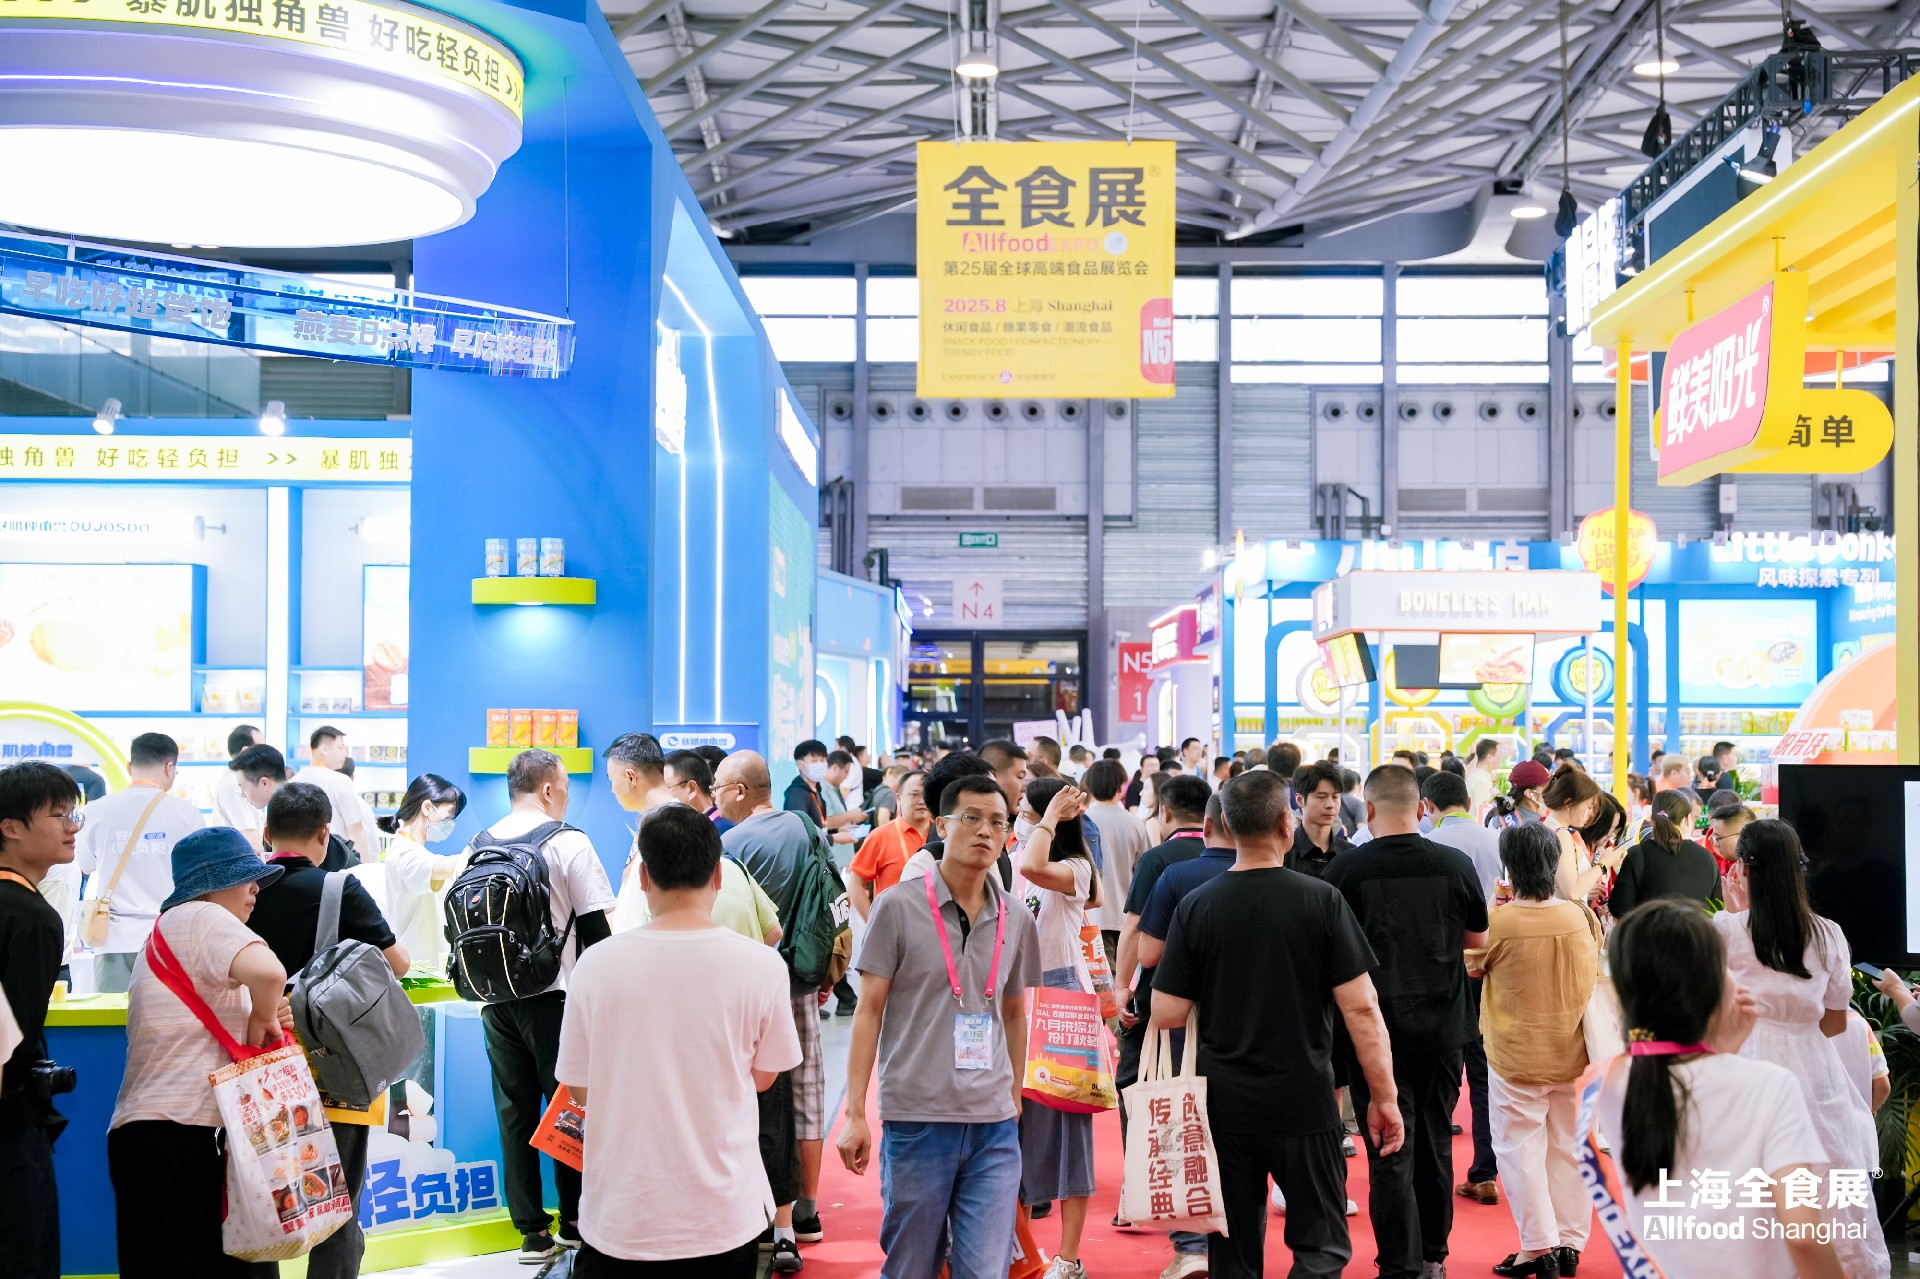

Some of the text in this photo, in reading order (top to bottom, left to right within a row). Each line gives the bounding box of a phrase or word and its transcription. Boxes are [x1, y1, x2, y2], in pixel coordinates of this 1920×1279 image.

[368, 13, 501, 94] 好吃轻负担
[943, 165, 1146, 228] 全食展
[943, 260, 1149, 276] 第25届全球高端食品展览会
[23, 270, 232, 330] 早吃好超管饱
[944, 298, 1113, 314] 2025.8 上海 Shanghai
[1143, 329, 1171, 365] N5
[1666, 319, 1762, 447] 鲜美阳光
[96, 446, 240, 469] 好吃轻负担
[319, 448, 412, 471] 暴肌独
[1818, 531, 1896, 564] Donk
[1757, 567, 1880, 589] 风味探索专列
[962, 602, 993, 620] N4
[1399, 591, 1552, 613] BONELESS MAN
[1123, 651, 1153, 673] N5
[1133, 691, 1142, 712] 1
[1036, 1008, 1050, 1017] SIAL
[1035, 1018, 1098, 1035] 九月来深圳
[1047, 1031, 1101, 1048] 抢订秋冬
[358, 1158, 498, 1231] 轻负担
